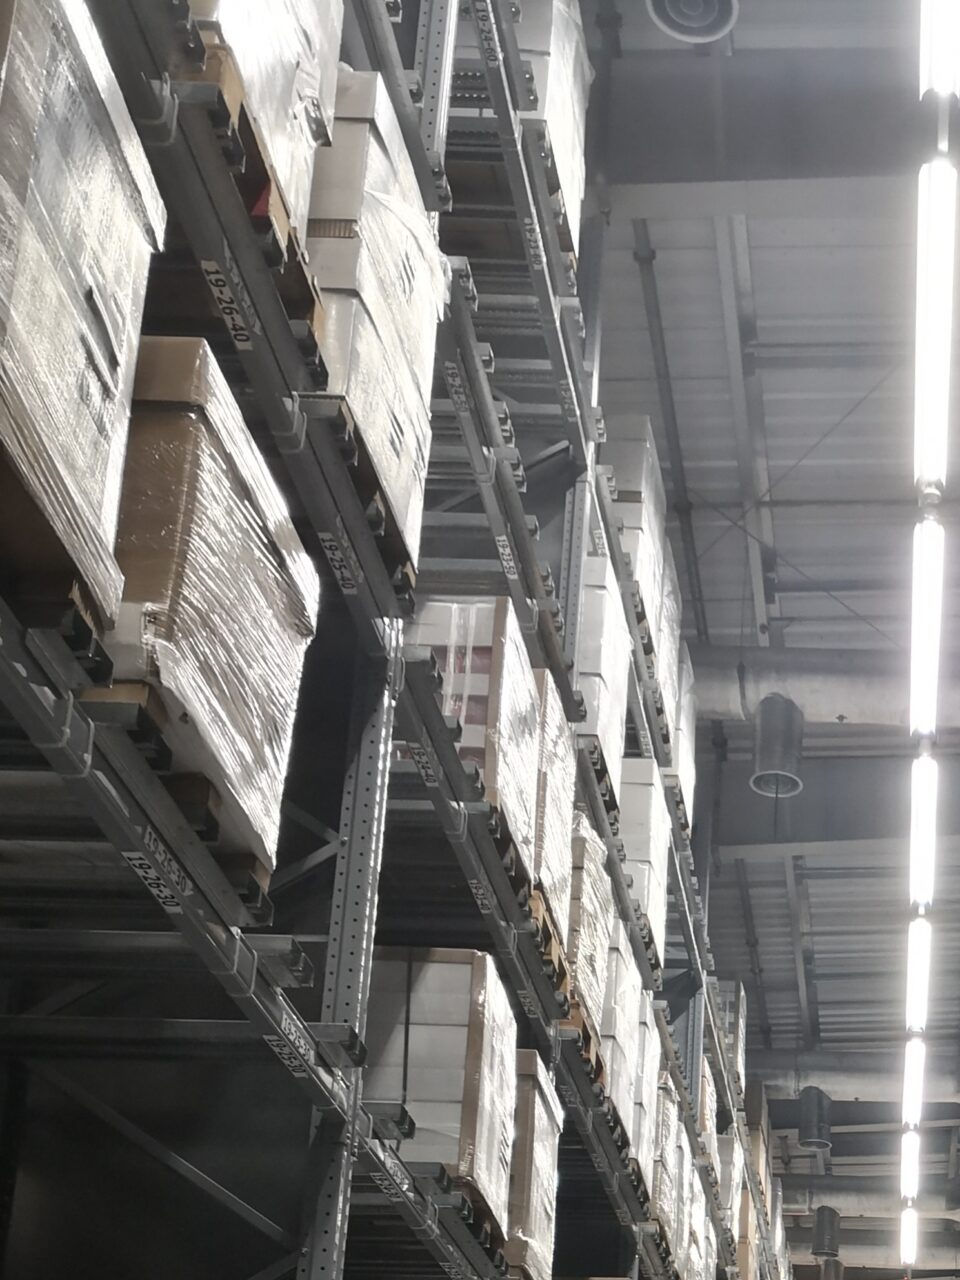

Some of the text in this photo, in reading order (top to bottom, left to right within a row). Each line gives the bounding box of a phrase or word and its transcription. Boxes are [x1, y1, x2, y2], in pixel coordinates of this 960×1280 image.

[476, 7, 498, 62] 19-24-60
[204, 266, 251, 344] 19-26-40
[321, 536, 356, 590] 19-25-40
[497, 539, 517, 576] 19-23-50
[127, 855, 181, 908] 19-26-30
